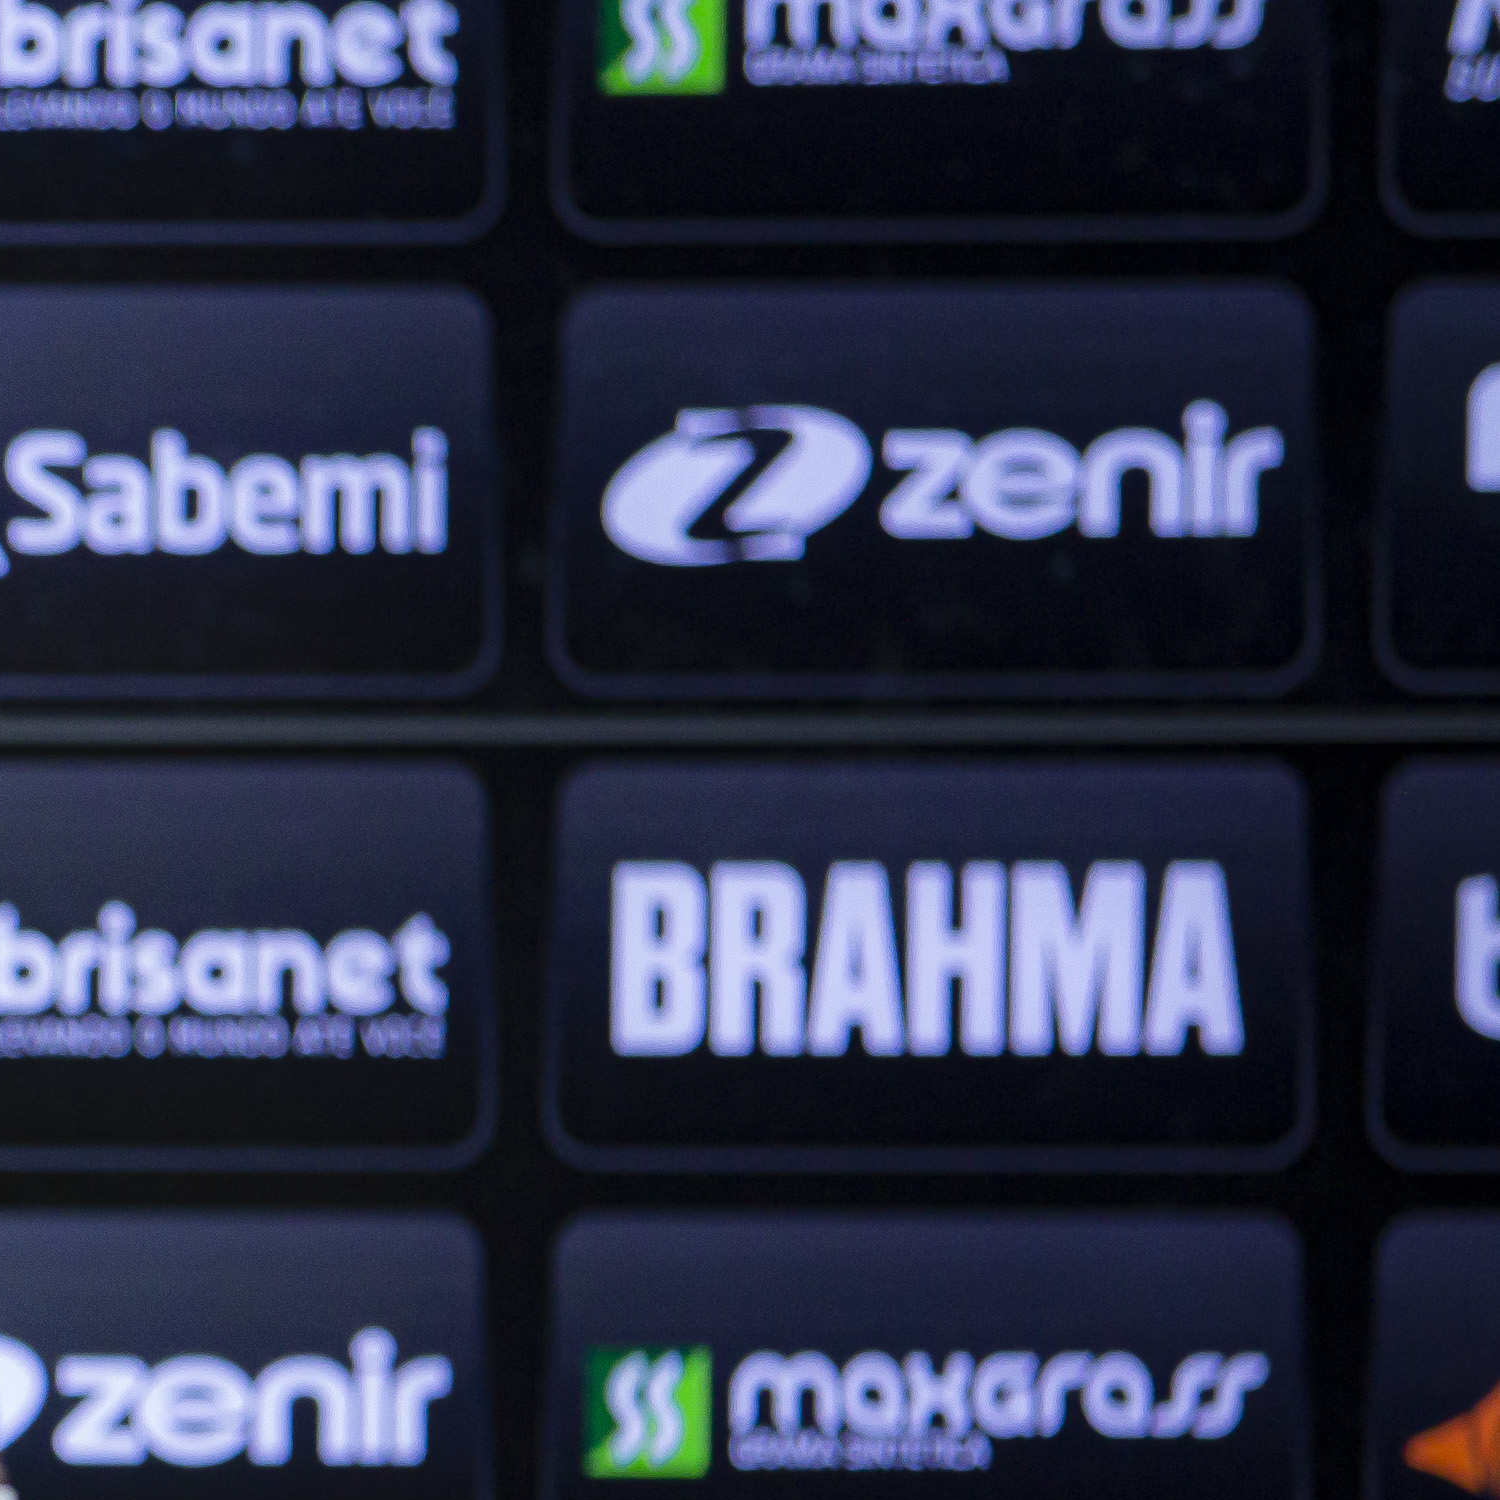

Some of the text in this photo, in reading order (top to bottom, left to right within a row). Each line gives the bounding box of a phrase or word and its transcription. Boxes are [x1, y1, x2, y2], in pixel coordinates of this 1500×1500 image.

[4, 427, 448, 555] Sabemi
[880, 400, 1285, 539] zenir
[610, 860, 1245, 1056] BRAHMA
[52, 1327, 454, 1465] zenir
